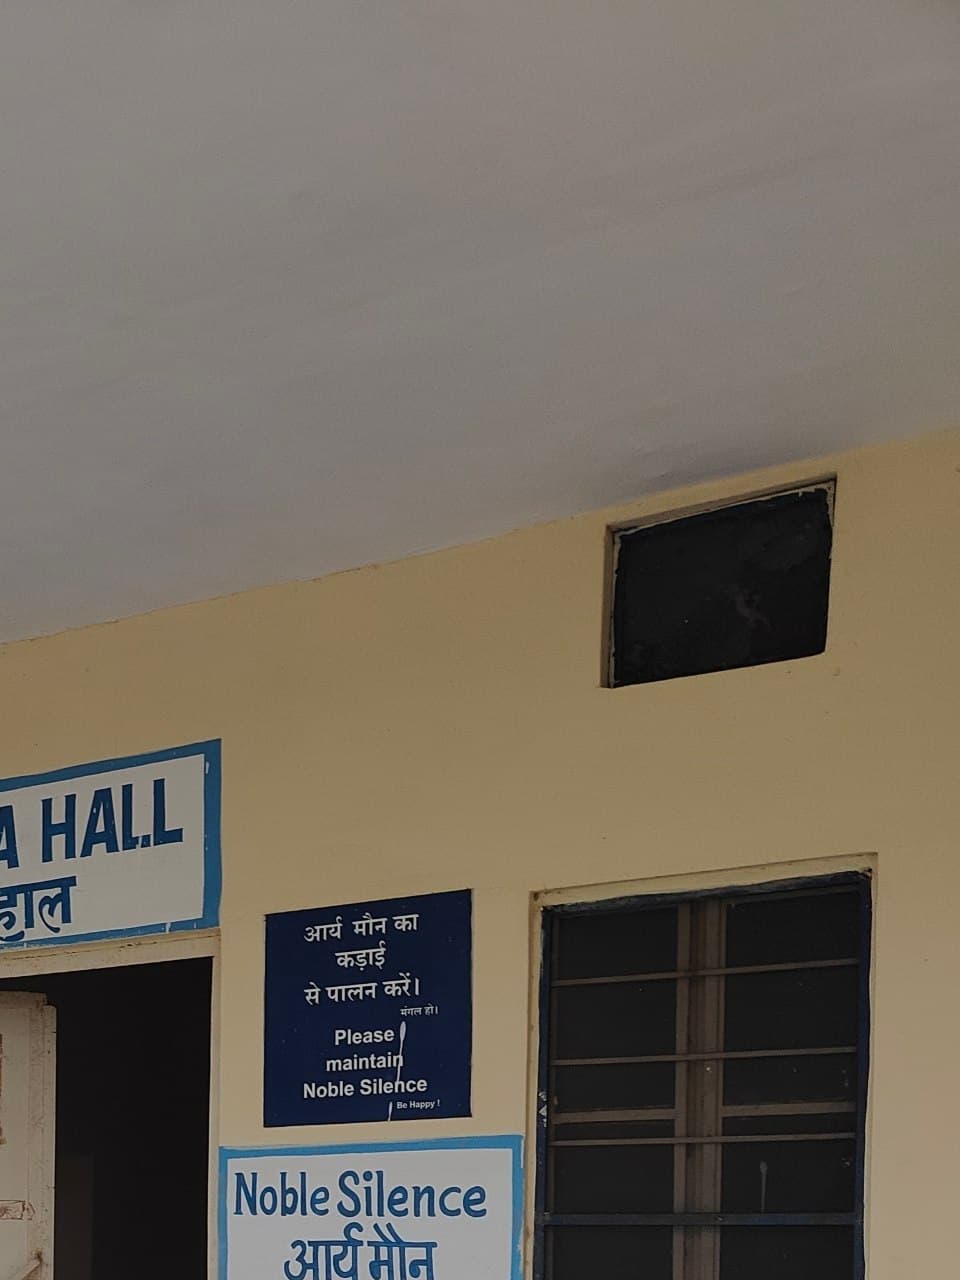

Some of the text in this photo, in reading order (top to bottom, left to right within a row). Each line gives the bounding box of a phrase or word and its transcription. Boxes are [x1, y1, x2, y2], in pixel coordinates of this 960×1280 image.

[42, 778, 183, 863] HALL
[304, 912, 419, 941] आर्य मौन का
[335, 940, 386, 970] कड़ाई
[304, 972, 419, 1005] से पालन करें।
[400, 1003, 438, 1016] मंगल हो।
[335, 1029, 394, 1045] Please
[326, 1050, 403, 1071] maintain
[304, 1076, 427, 1098] Noble Silence
[397, 1101, 435, 1109] Be Happy
[233, 1170, 487, 1218] Noble Silence
